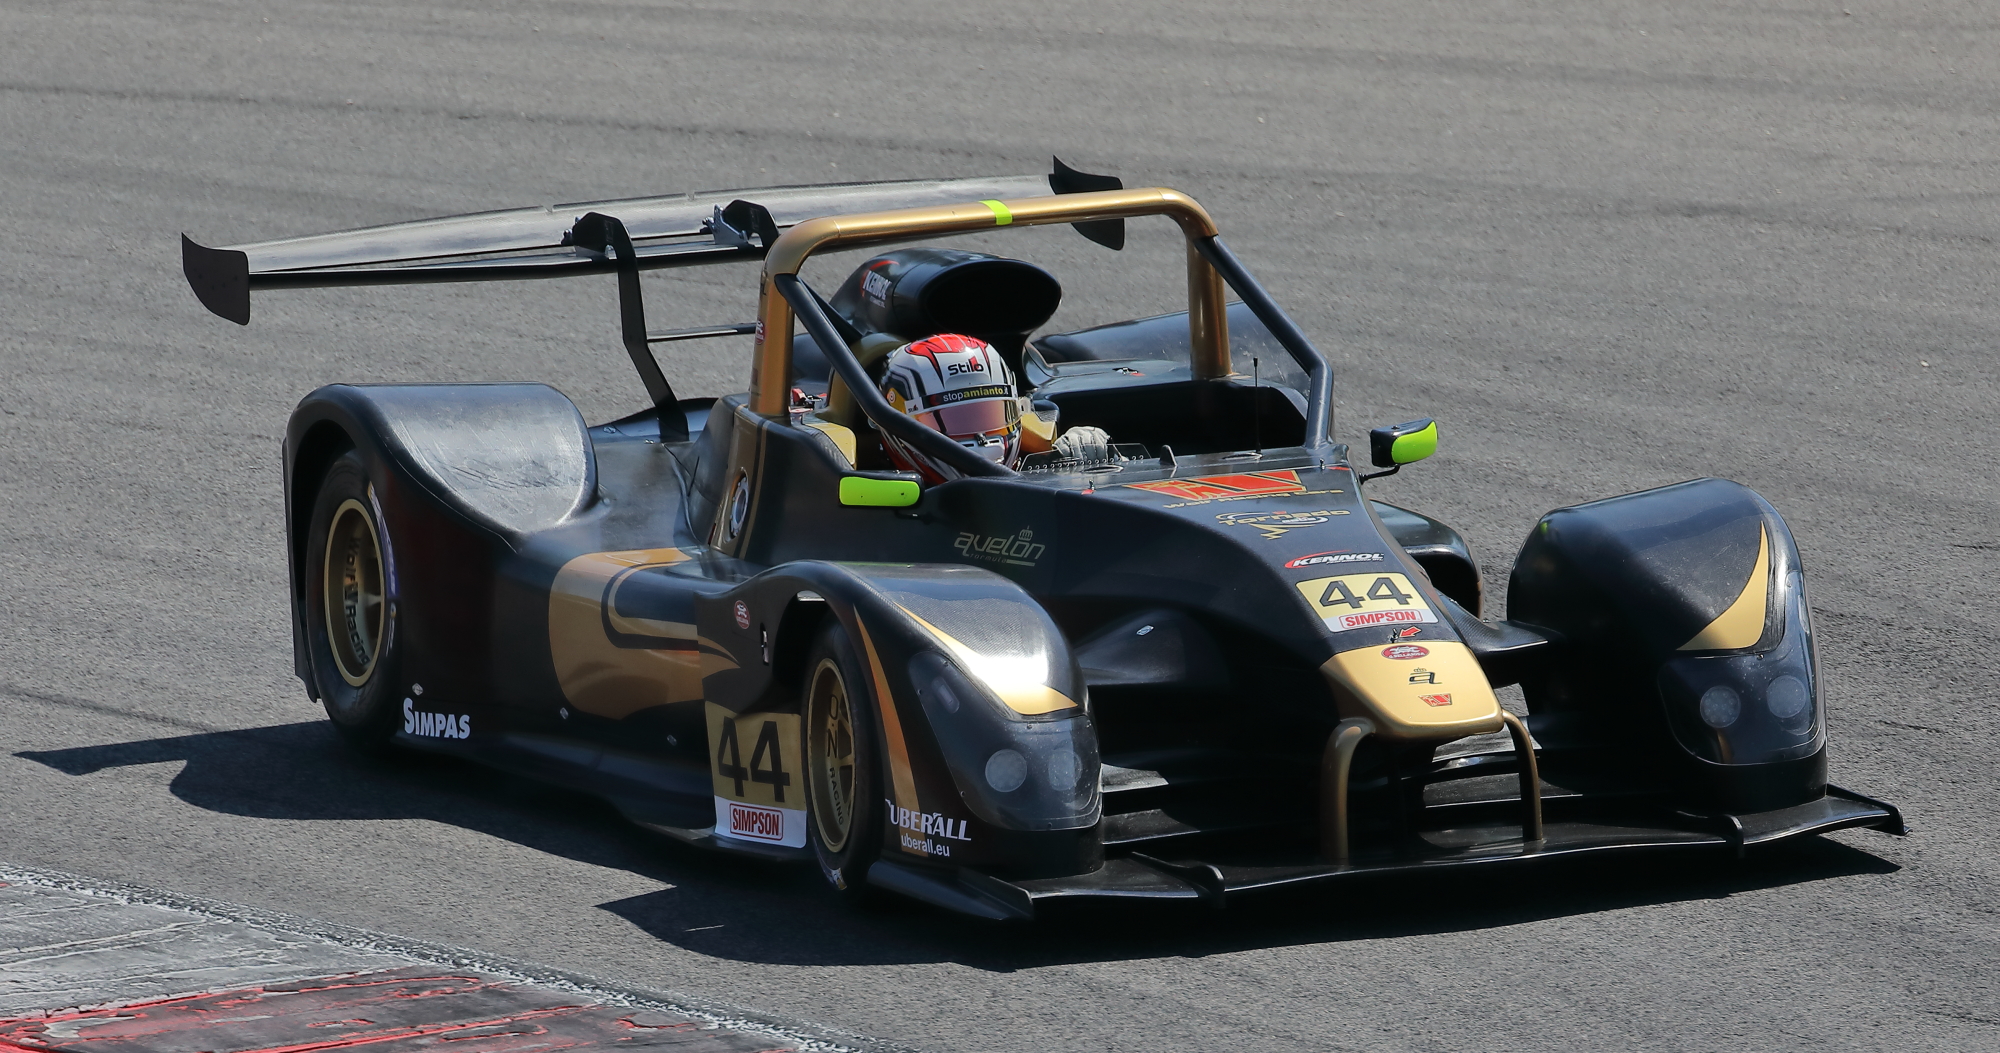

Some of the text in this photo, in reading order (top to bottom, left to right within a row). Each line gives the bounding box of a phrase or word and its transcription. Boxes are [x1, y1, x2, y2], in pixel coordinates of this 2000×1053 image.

[947, 357, 985, 376] Stilo
[943, 386, 1009, 402] stopamianto.it
[953, 531, 1046, 560] avelon
[1292, 553, 1385, 567] KENNOL
[1318, 577, 1414, 609] 44
[1345, 611, 1417, 627] SIMPSON
[403, 697, 471, 740] SIMPAS
[717, 716, 791, 803] 44
[829, 767, 845, 826] RACING
[732, 808, 780, 836] SIMPSON
[901, 833, 950, 857] uberall.eu
